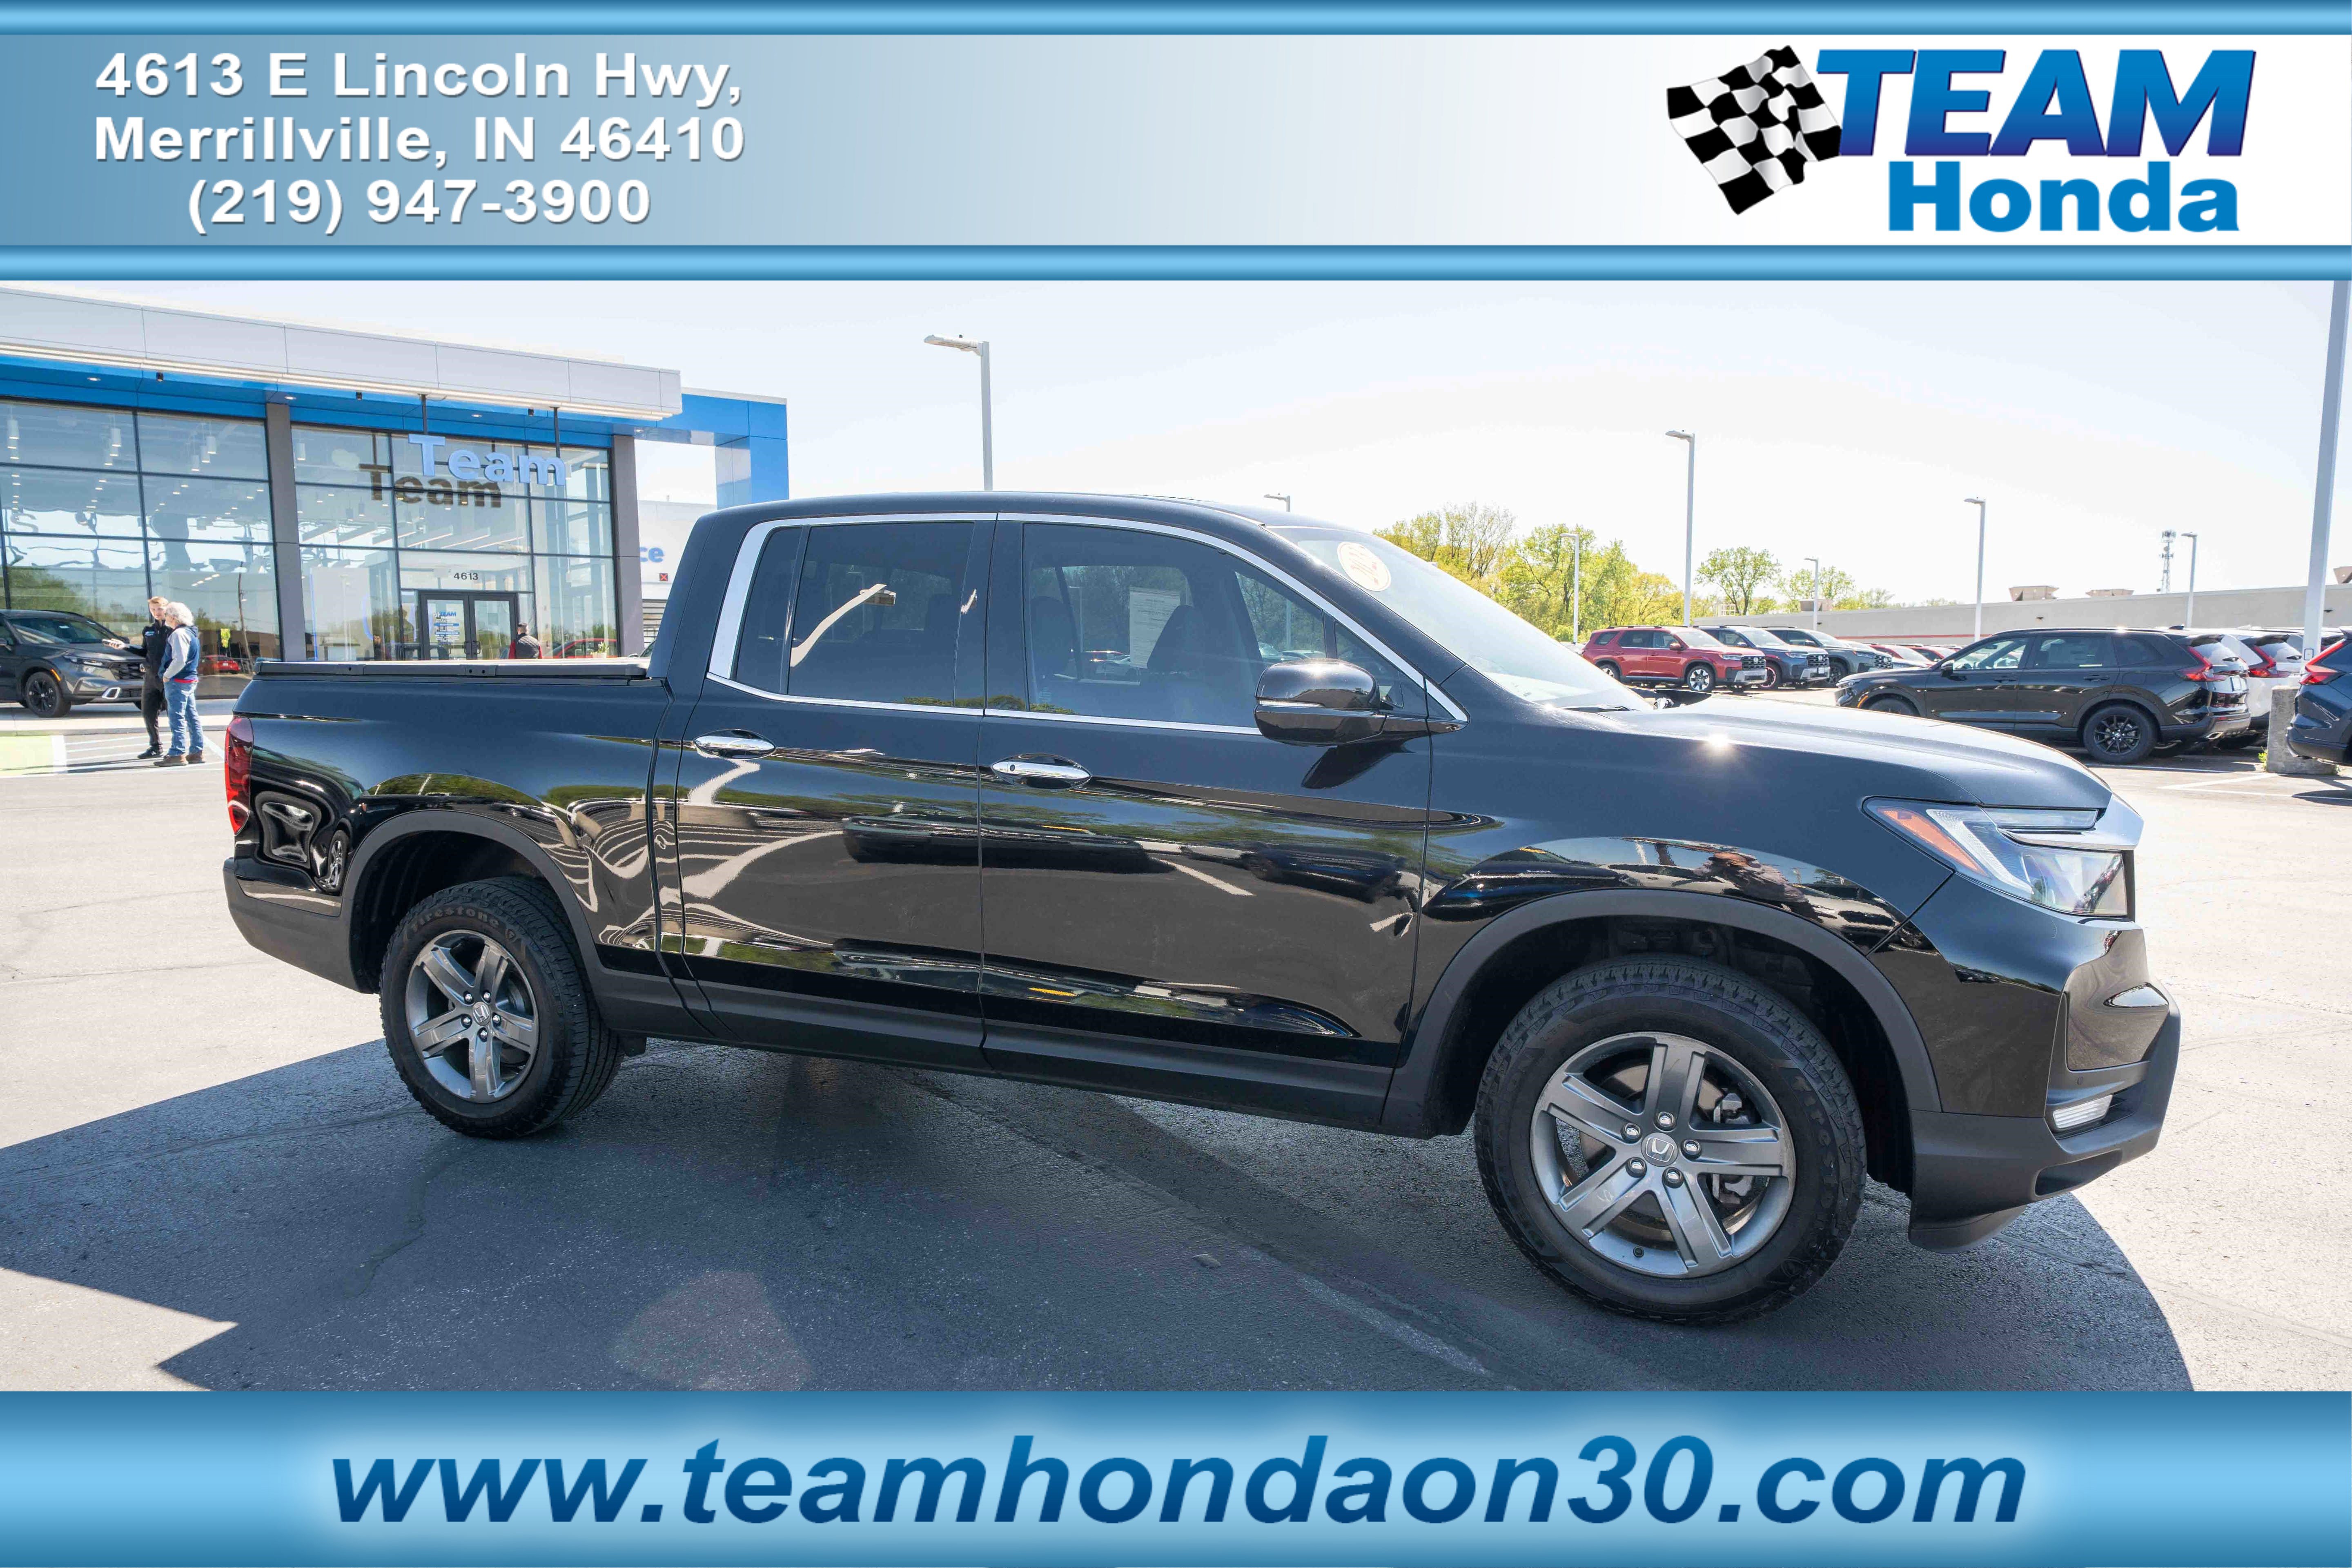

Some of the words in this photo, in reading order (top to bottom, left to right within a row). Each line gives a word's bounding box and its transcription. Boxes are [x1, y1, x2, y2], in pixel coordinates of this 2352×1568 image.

[409, 434, 566, 486] Team
[359, 463, 501, 508] Team
[454, 572, 478, 580] 4613
[410, 905, 499, 933] Firestone
